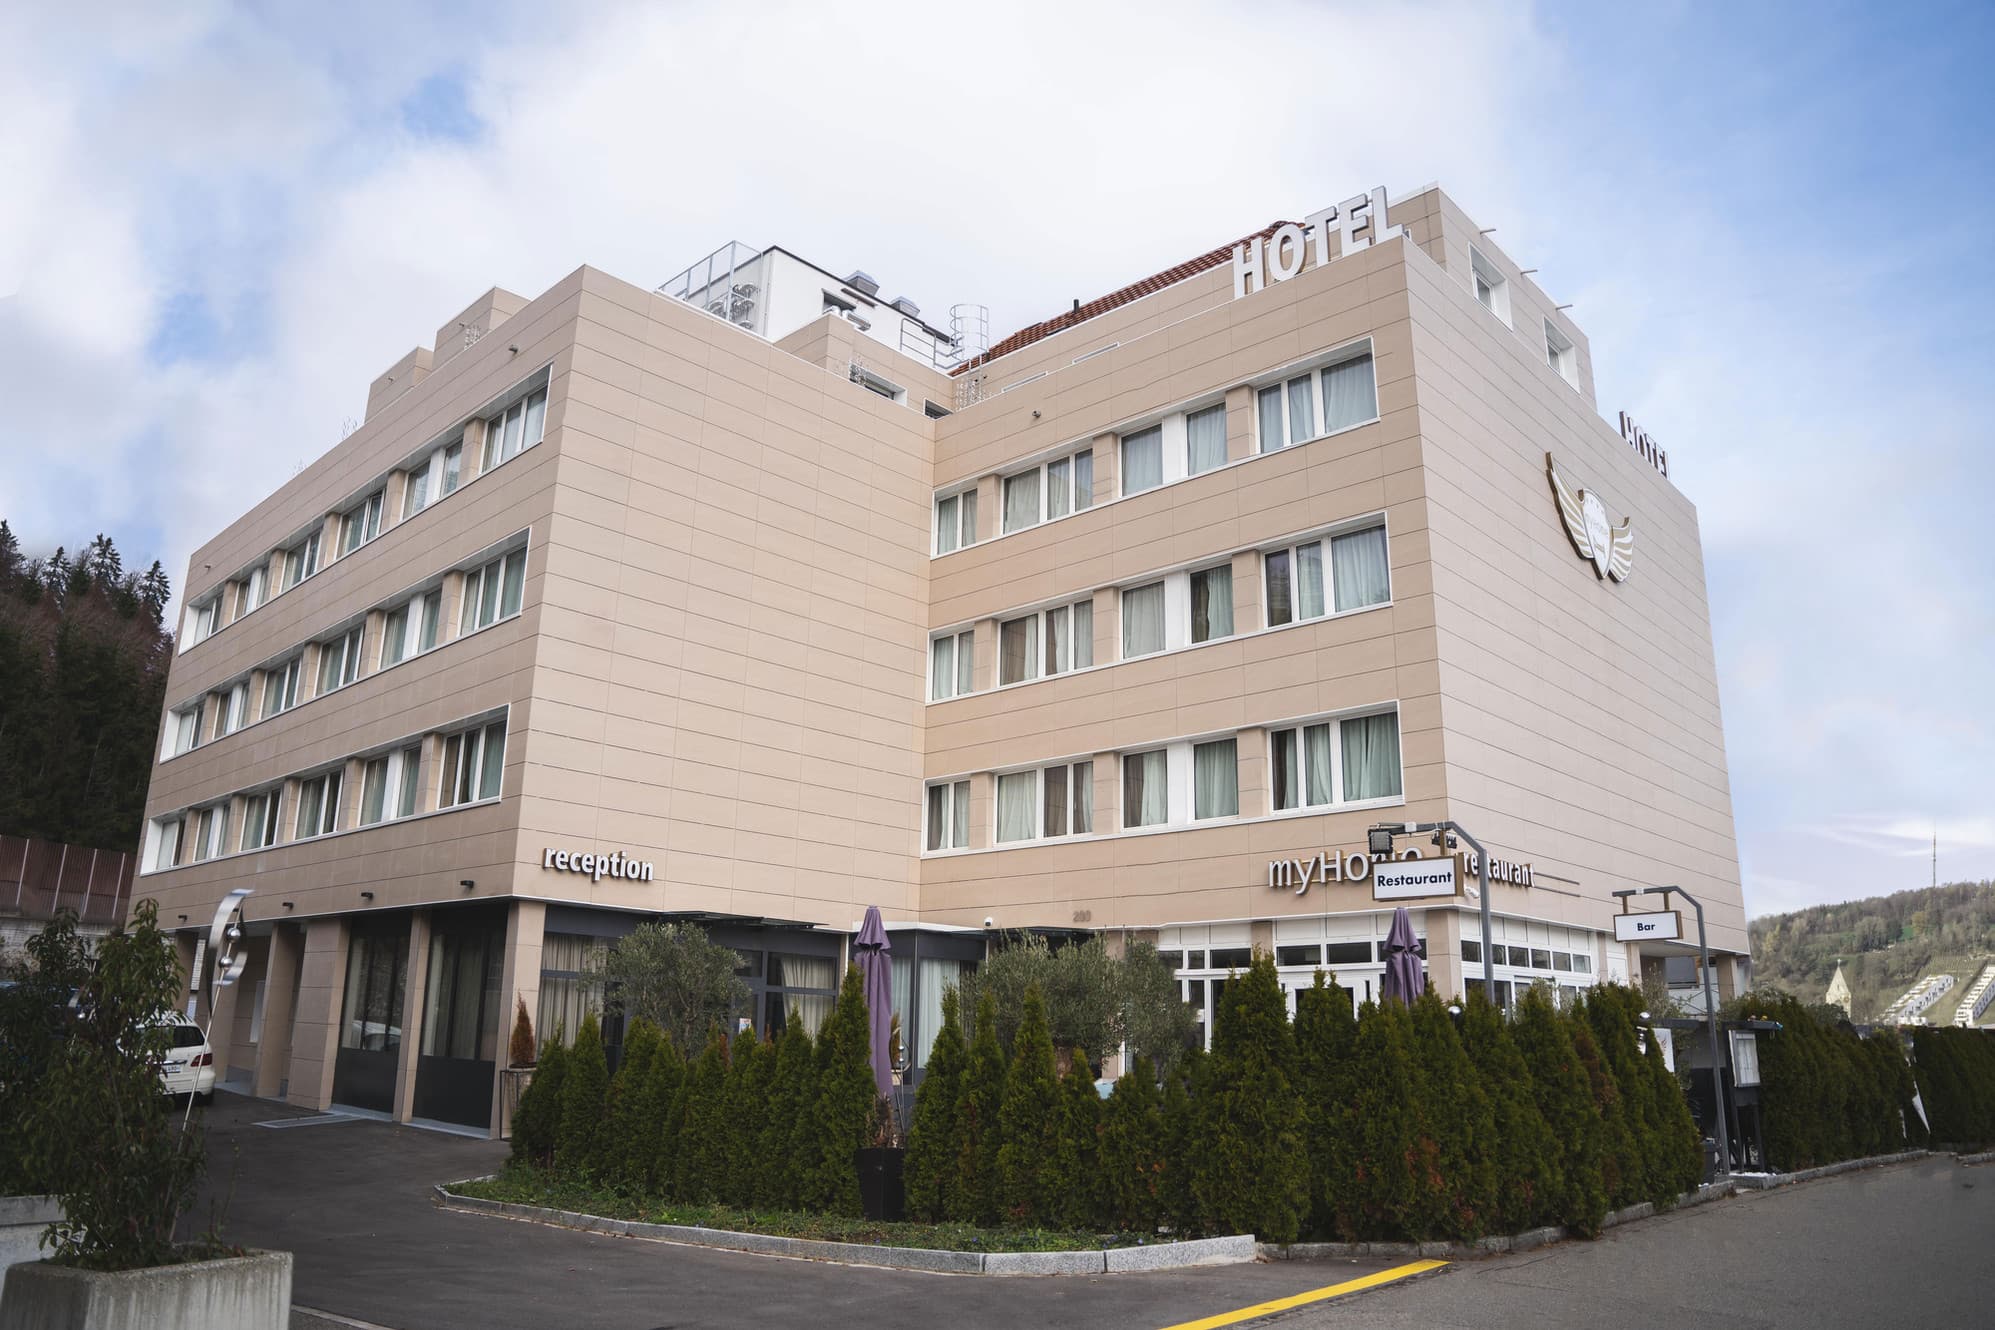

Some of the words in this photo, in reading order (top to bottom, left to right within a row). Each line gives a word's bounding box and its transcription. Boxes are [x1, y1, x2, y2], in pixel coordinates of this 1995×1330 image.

[1232, 186, 1403, 300] HOTEL
[543, 847, 654, 881] reception
[1268, 847, 1423, 895] myHo
[1463, 851, 1534, 888] retaurant
[1377, 871, 1452, 887] Restaurant
[1636, 922, 1656, 932] Bar
